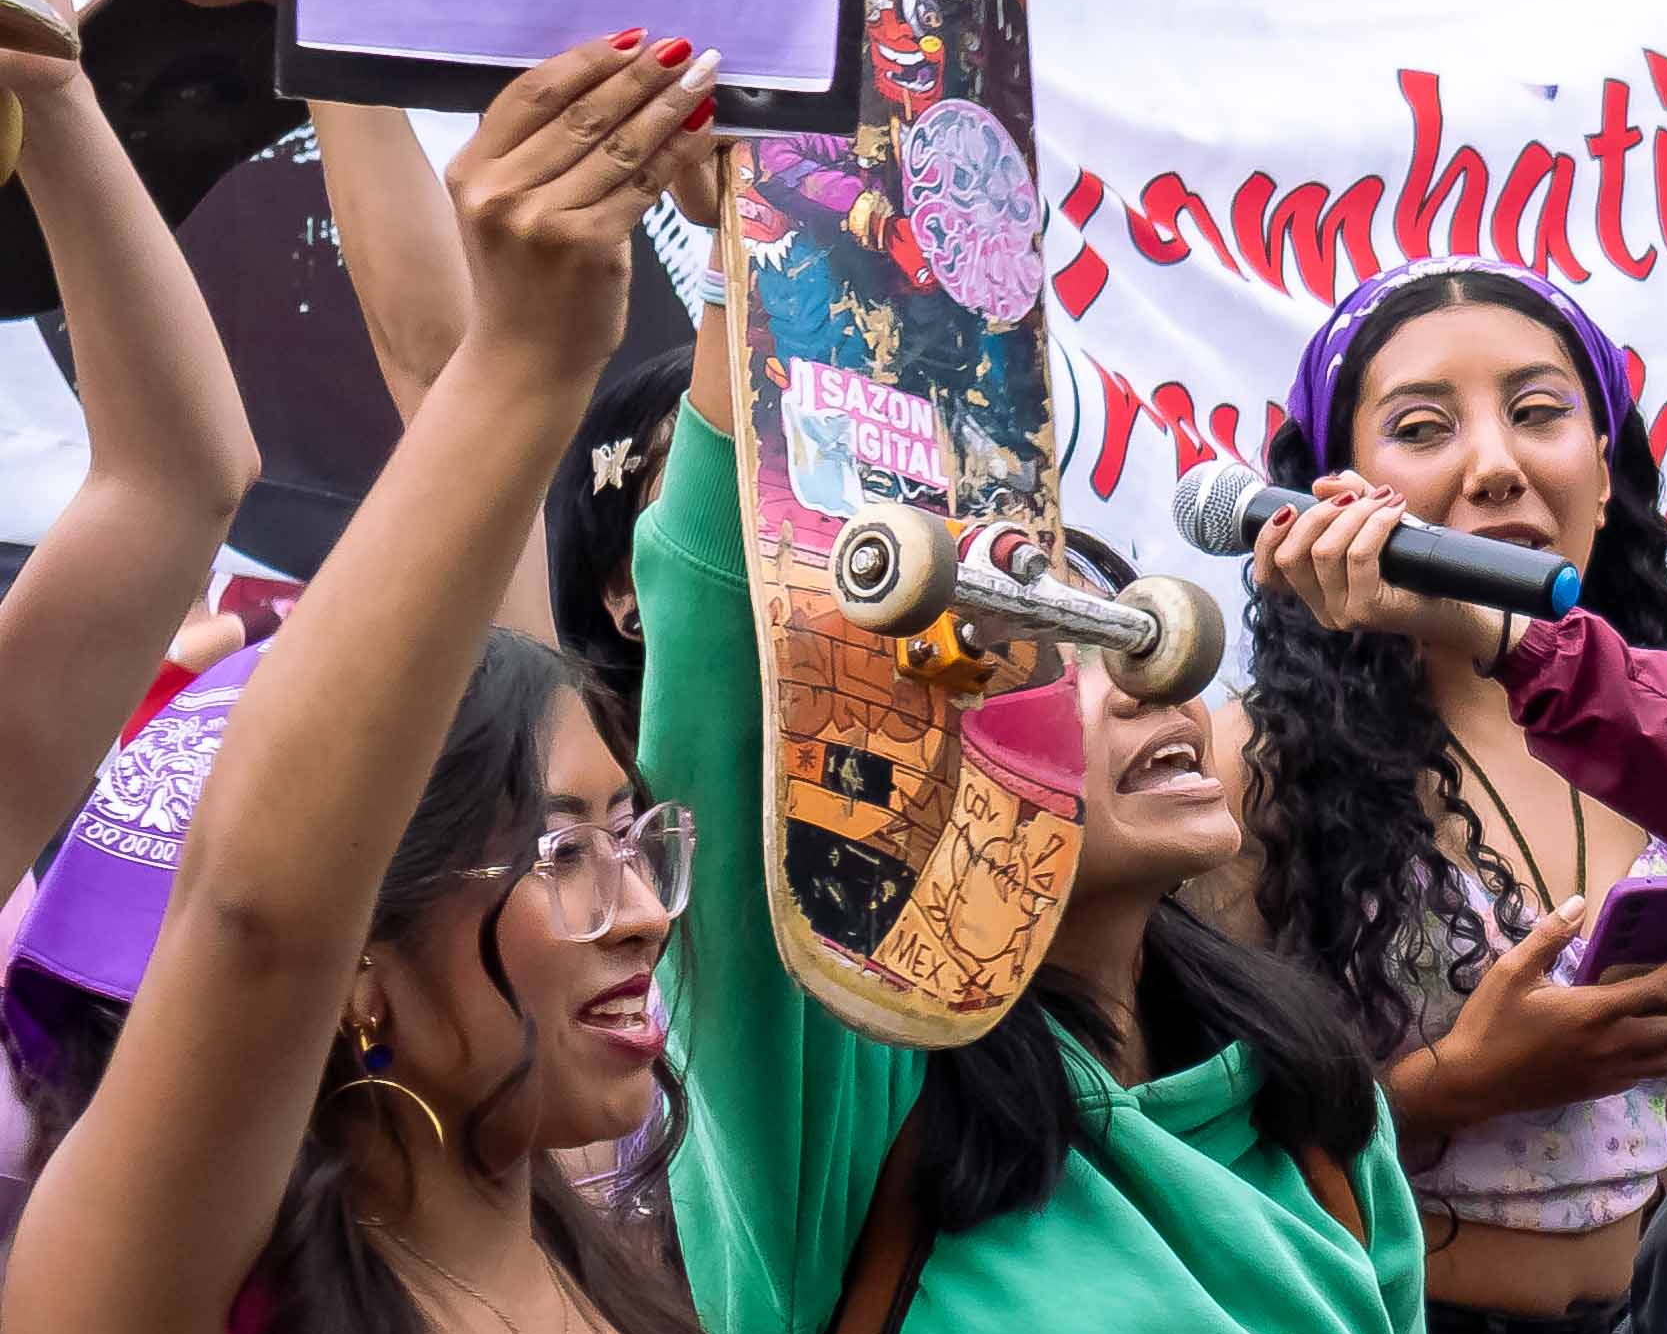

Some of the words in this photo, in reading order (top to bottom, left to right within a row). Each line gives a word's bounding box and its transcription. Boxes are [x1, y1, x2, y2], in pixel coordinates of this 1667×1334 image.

[820, 369, 934, 437] SAZON
[851, 418, 950, 487] IGITAL
[887, 928, 946, 986] MEX
